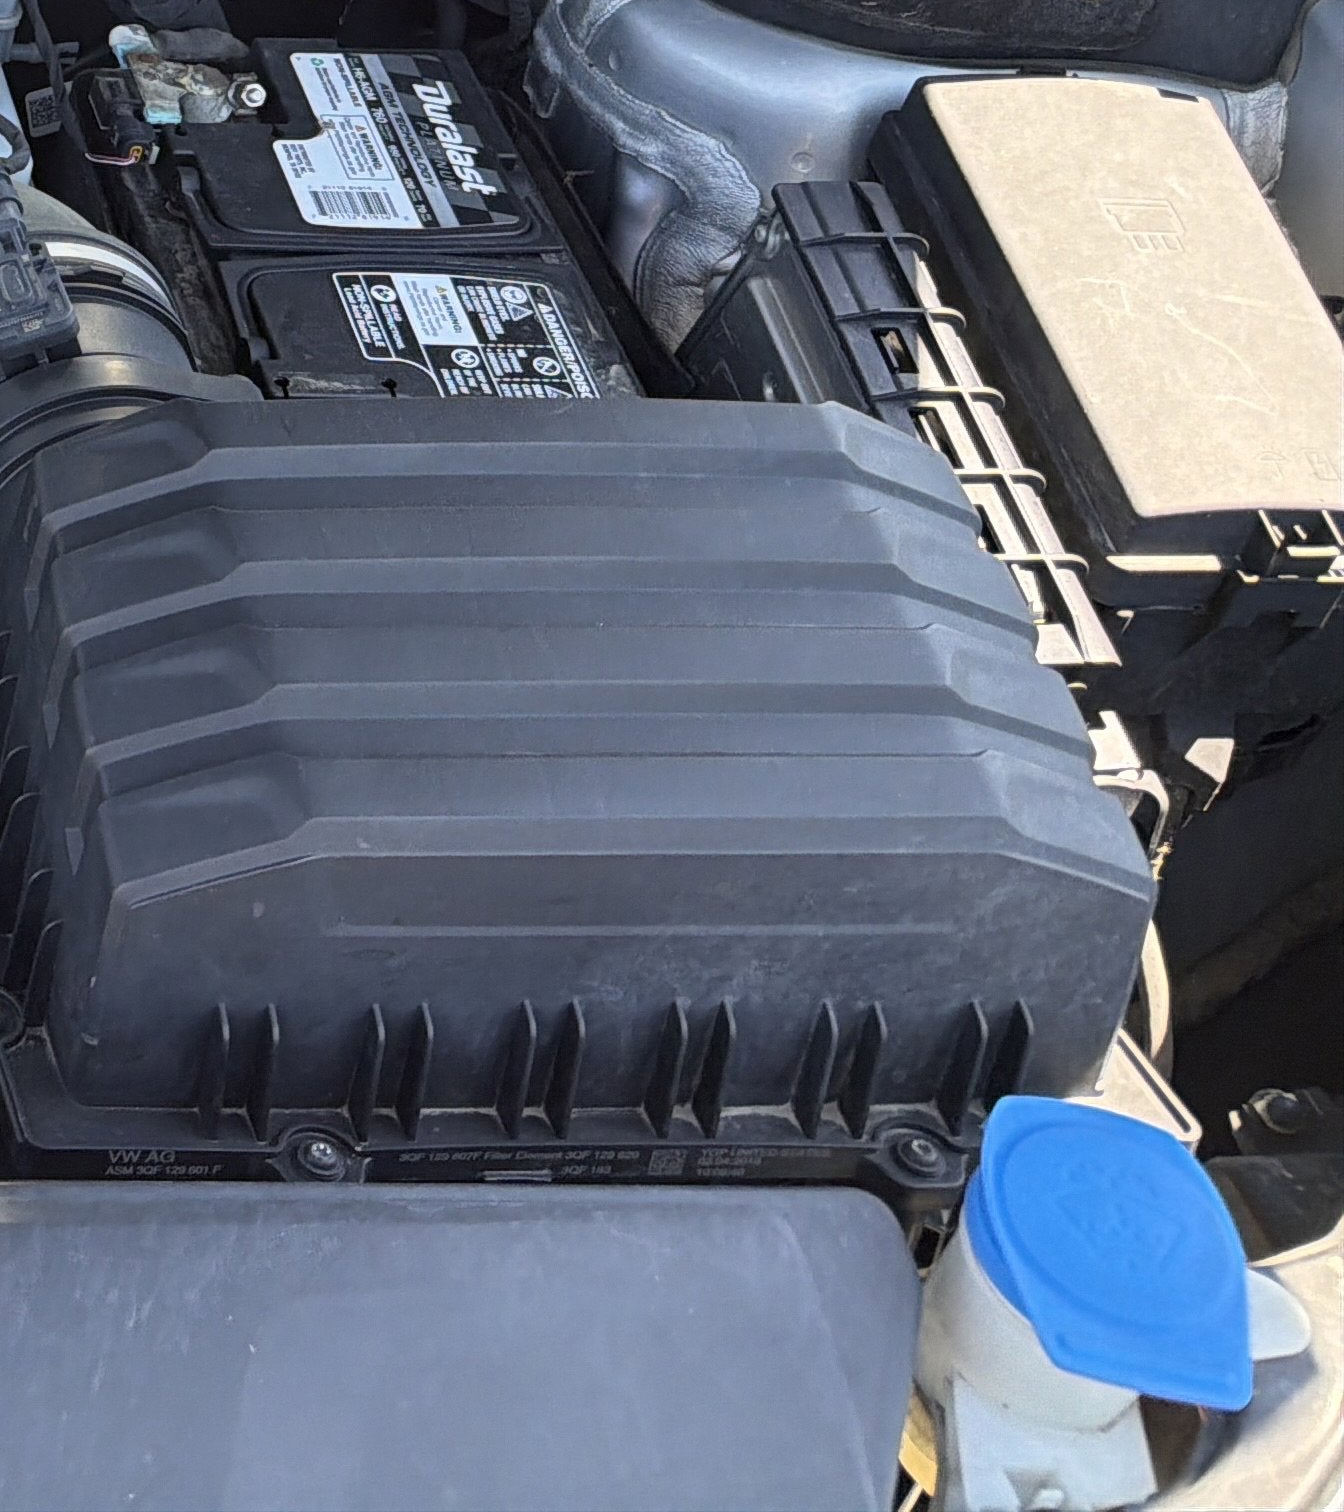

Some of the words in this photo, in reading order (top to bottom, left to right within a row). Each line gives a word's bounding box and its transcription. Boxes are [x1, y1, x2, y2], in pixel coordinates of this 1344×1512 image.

[369, 107, 388, 123] 760
[377, 82, 399, 107] AGM
[392, 112, 437, 187] TECHNOLOGY
[409, 80, 498, 194] Duralast
[415, 121, 459, 190] PLATINUM
[350, 284, 385, 346] NON-SPILLABLE
[109, 1150, 142, 1163] VW
[145, 1150, 175, 1163] AG
